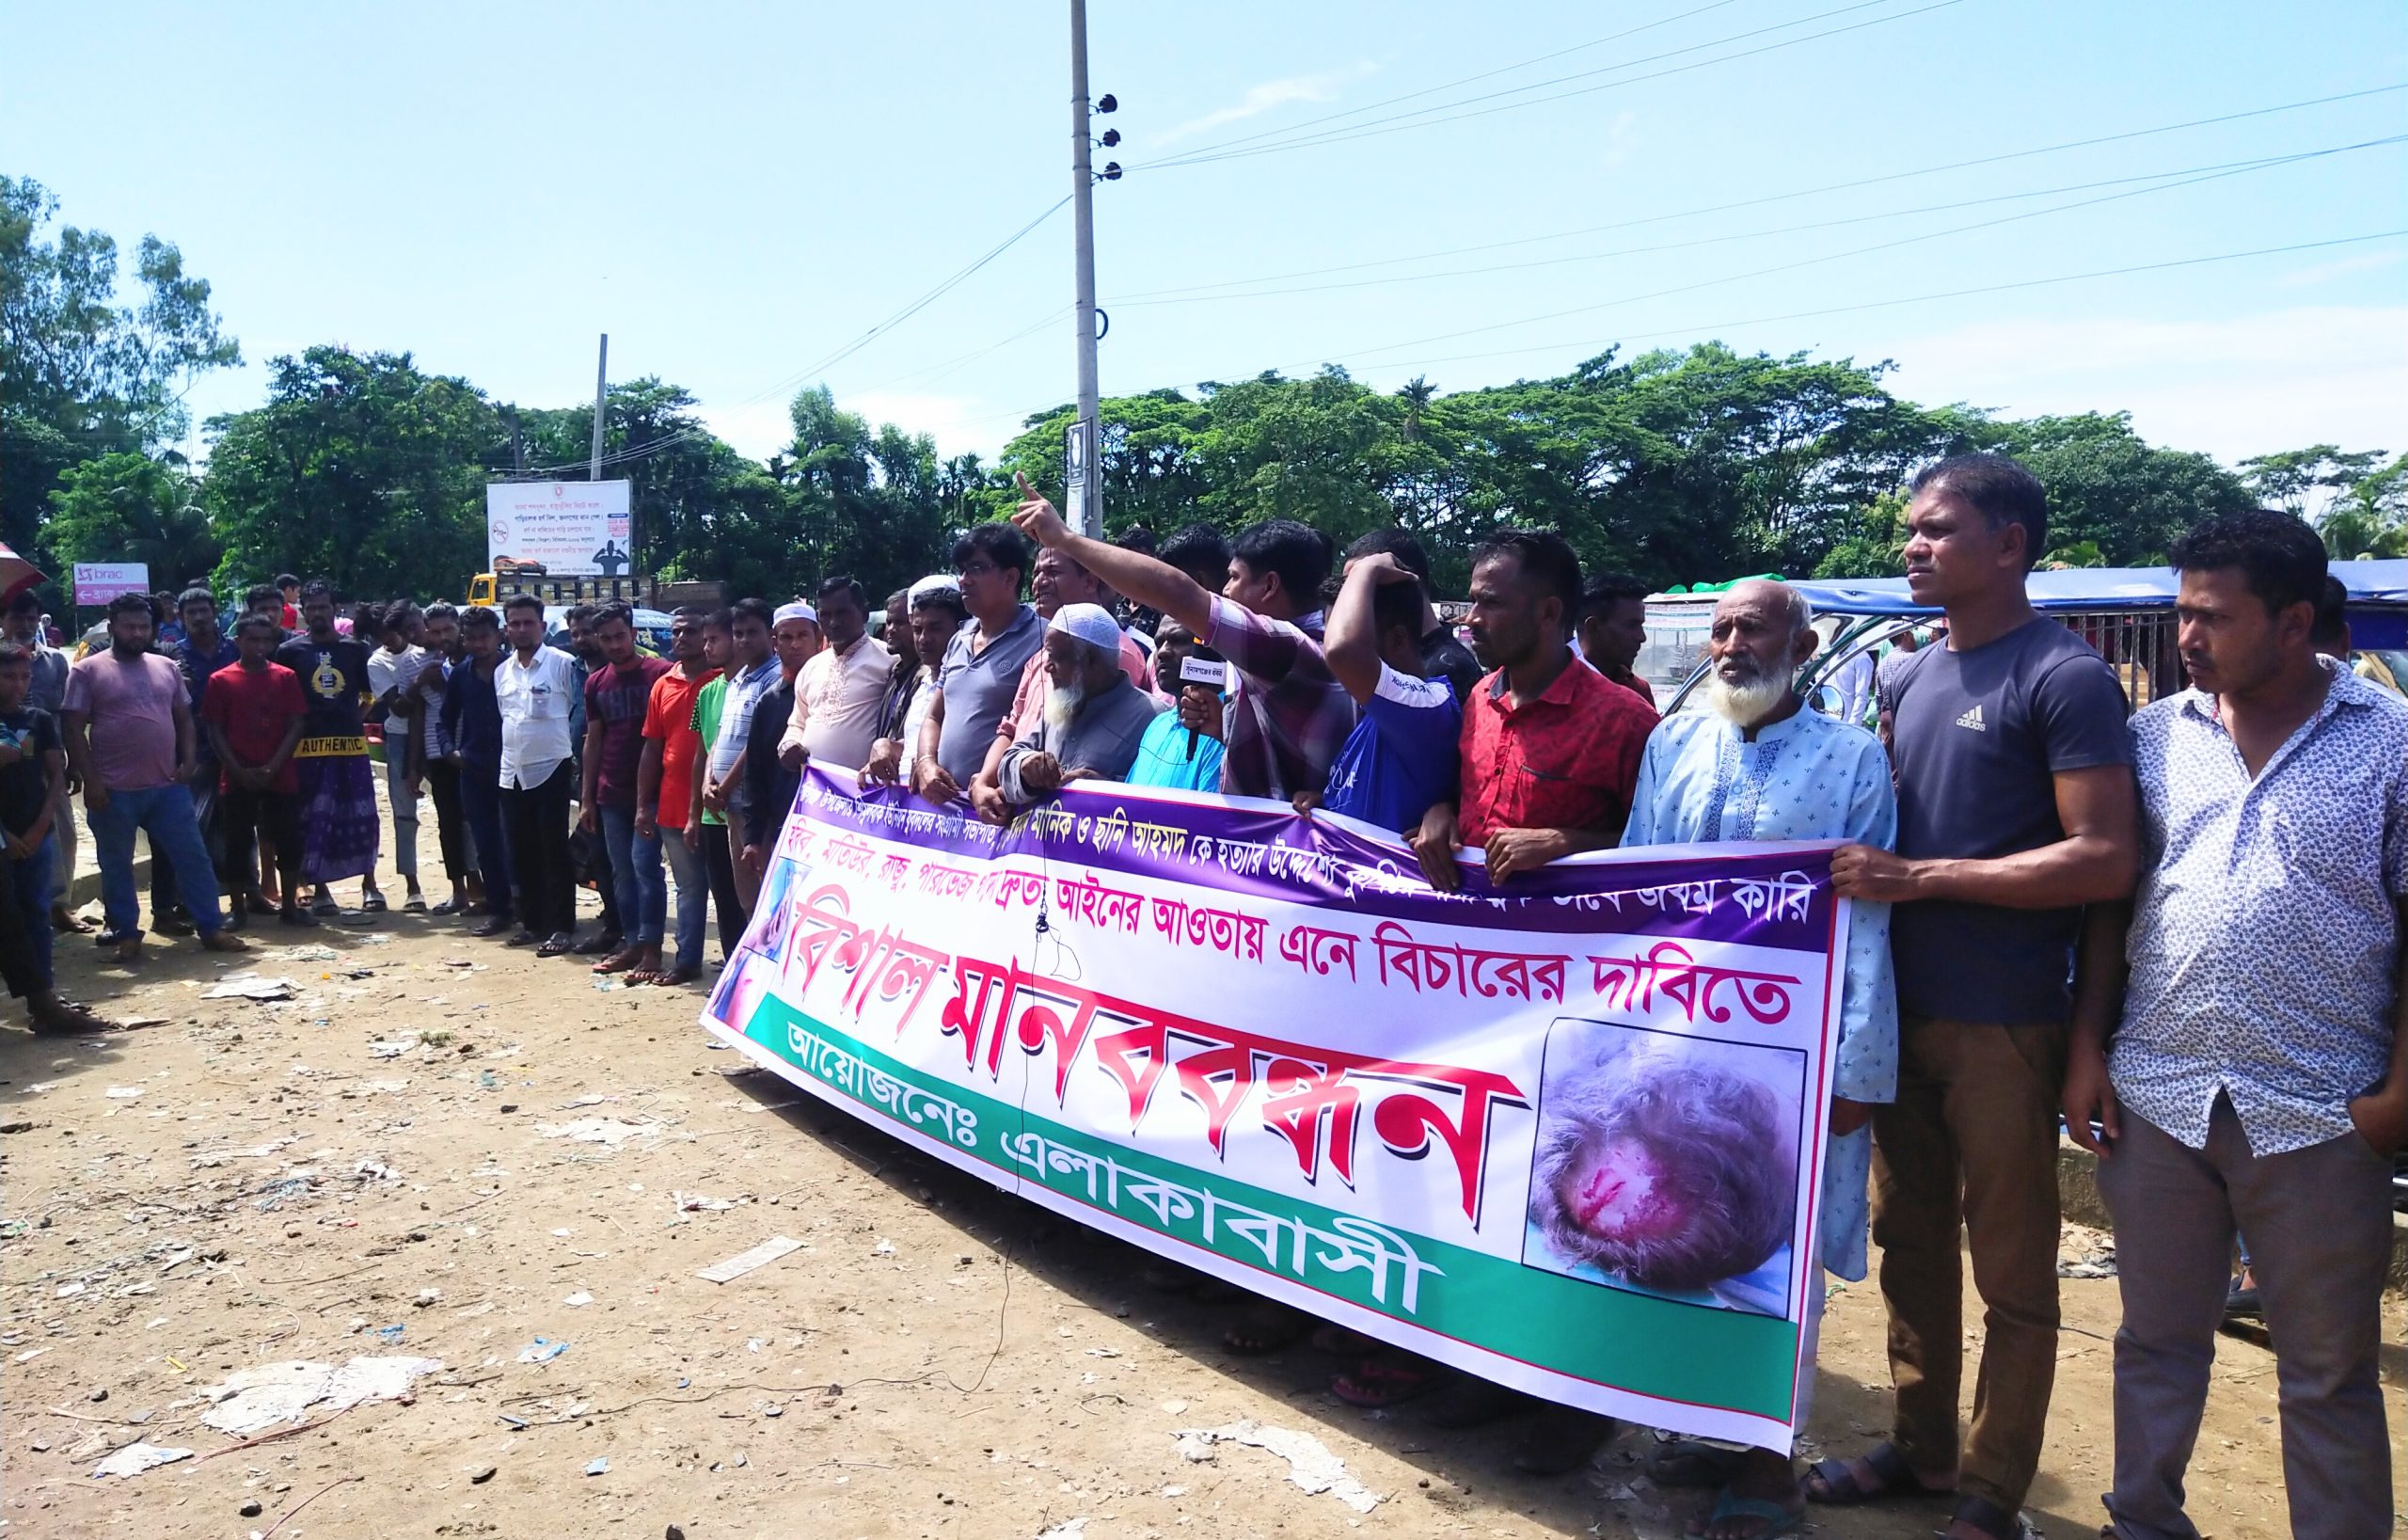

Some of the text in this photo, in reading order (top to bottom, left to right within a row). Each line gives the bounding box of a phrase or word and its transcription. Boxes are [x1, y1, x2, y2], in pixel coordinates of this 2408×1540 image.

[94, 568, 123, 579] brac
[1956, 718, 1986, 732] adidas
[1031, 799, 1076, 844] মানিক
[1077, 816, 1092, 844] ও
[1132, 820, 1188, 863] আহমদ
[1189, 834, 1213, 866] কে
[1217, 837, 1268, 876] হত্যার
[919, 861, 979, 902] পারভেজ
[1728, 870, 1817, 925] কারি
[995, 869, 1051, 912] দ্রুত
[1056, 869, 1146, 935] আইনের
[1151, 897, 1271, 965] আওতায়
[1279, 925, 1361, 984] এনে
[1370, 920, 1575, 1006] বিচারের
[1586, 941, 1802, 1025] দাবিতে
[782, 882, 1531, 1233] বিশাল মানববন্ধন
[1000, 1127, 1448, 1315] এলাকাবাসী
